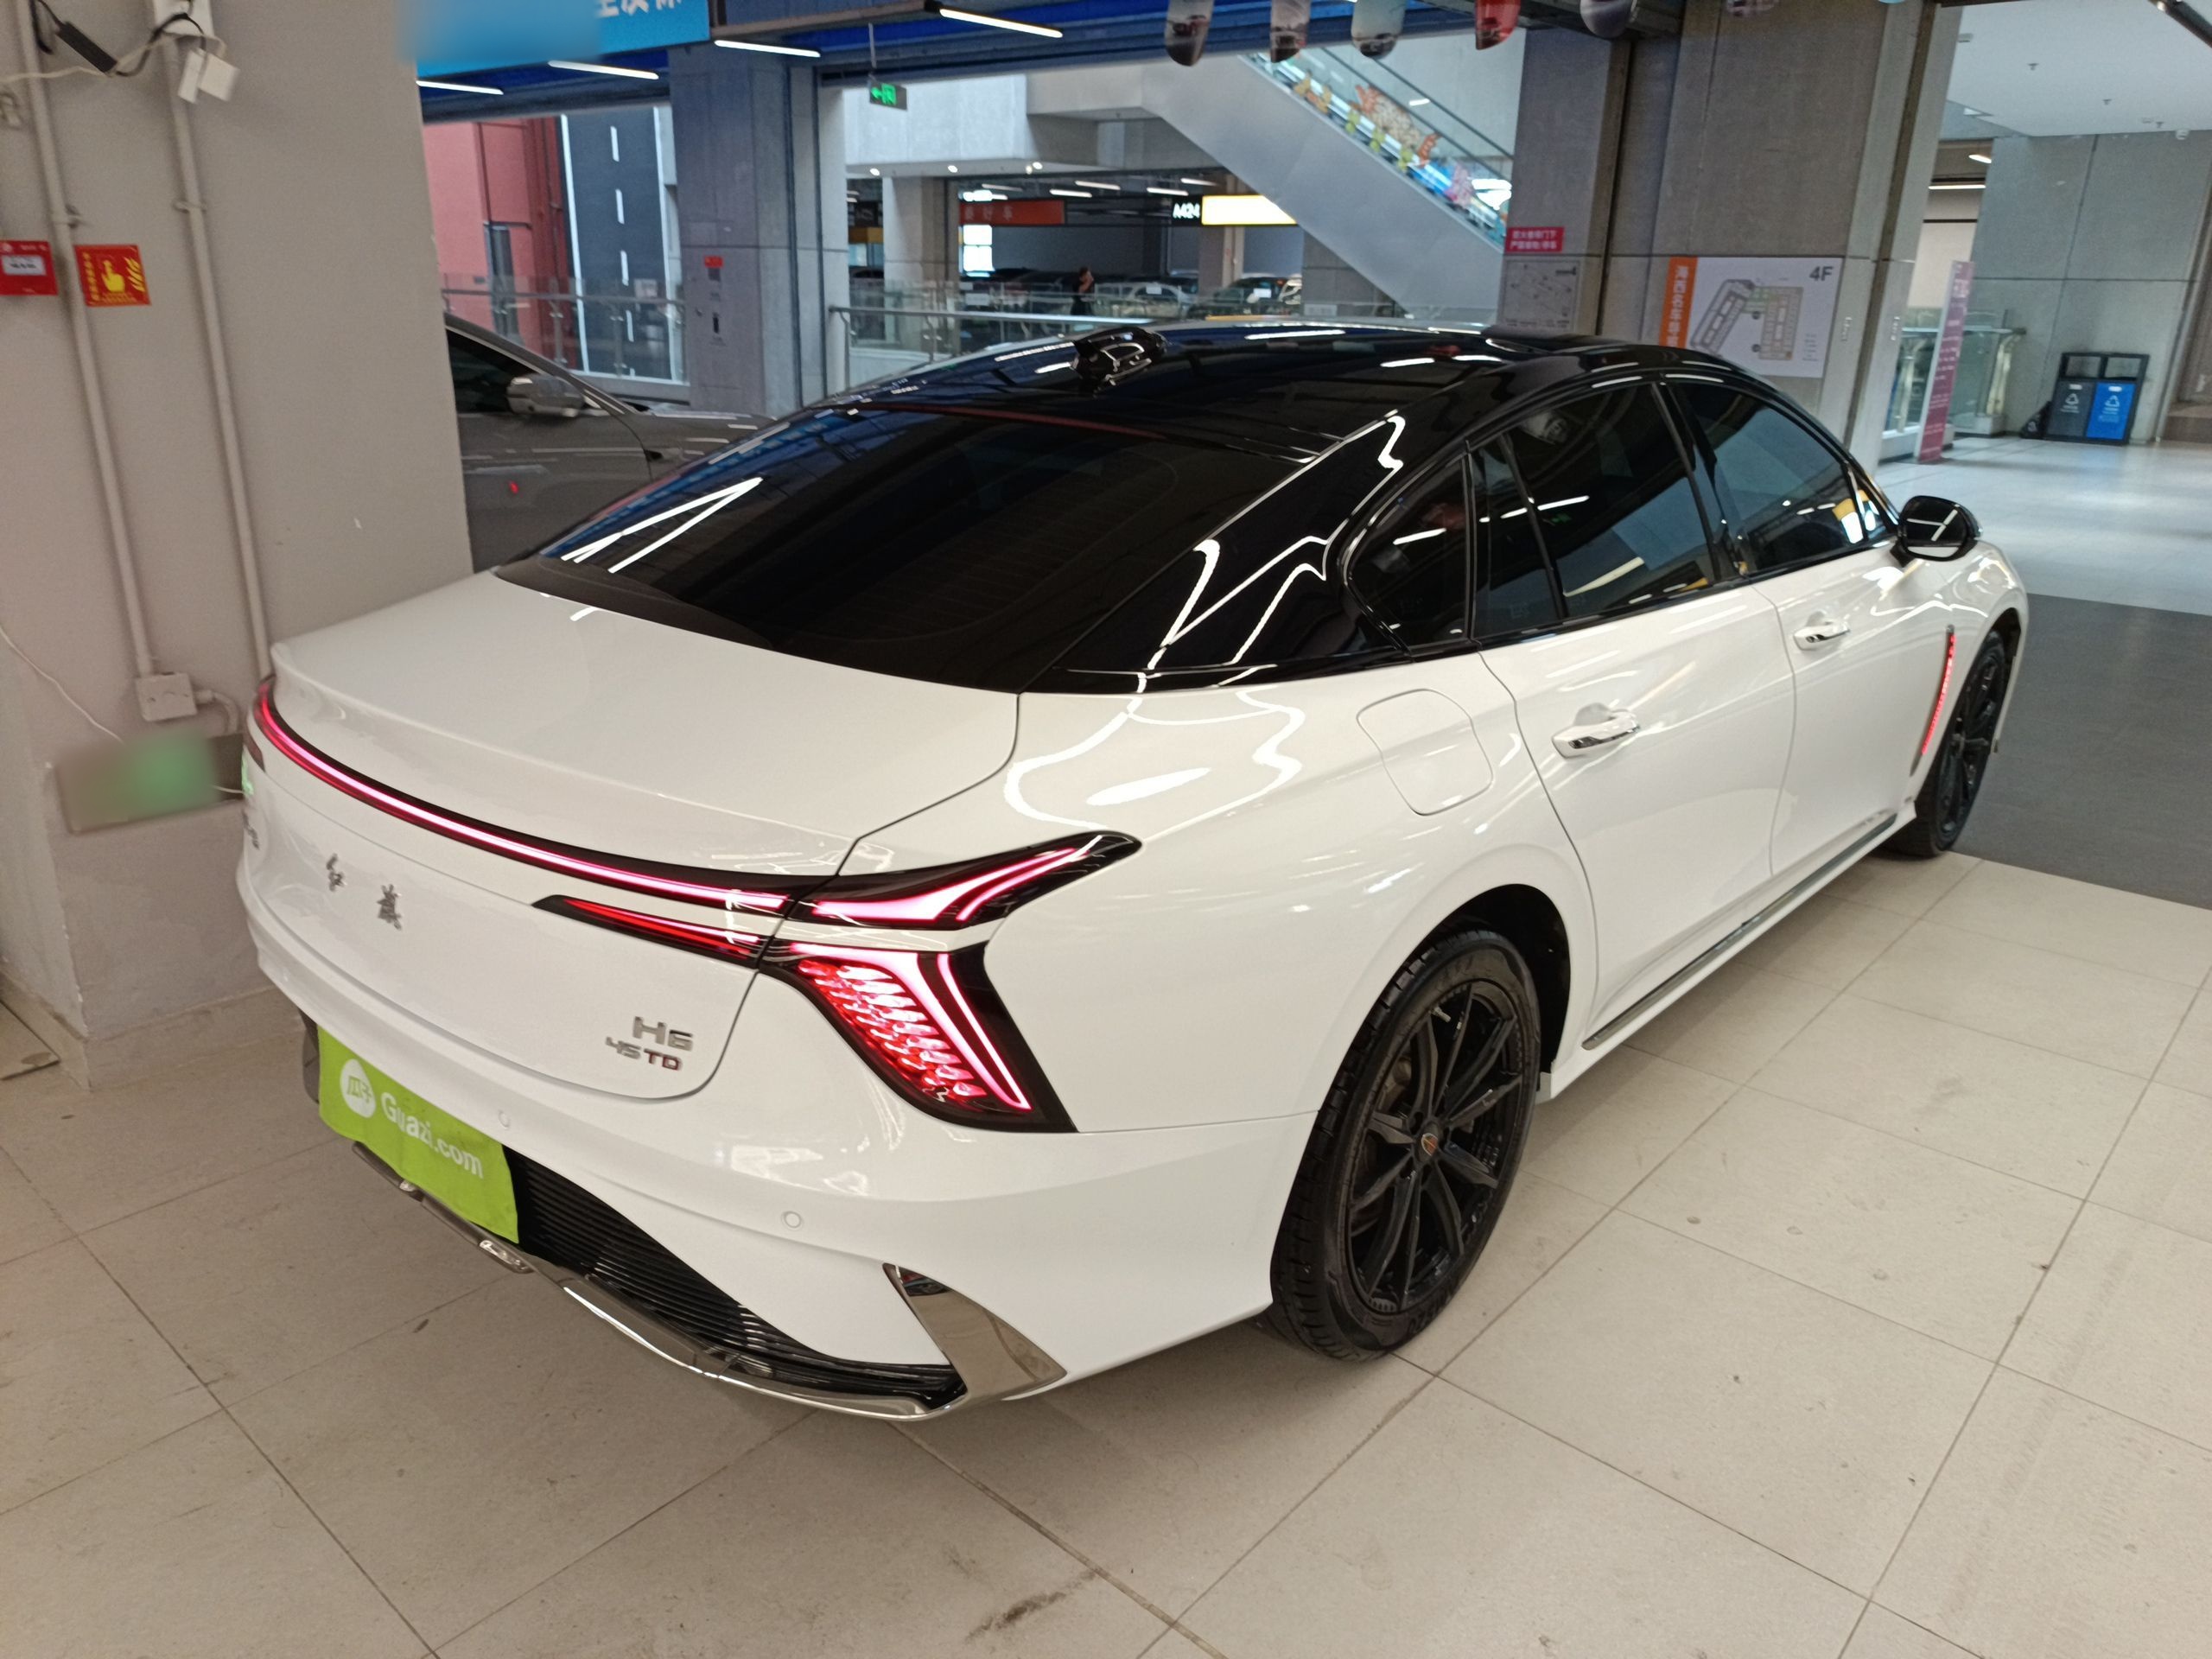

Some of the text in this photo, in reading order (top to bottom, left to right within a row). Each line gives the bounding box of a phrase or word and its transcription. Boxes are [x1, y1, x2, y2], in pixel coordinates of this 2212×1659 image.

[1809, 266, 1834, 282] 4F
[632, 1016, 694, 1052] H6
[380, 1091, 484, 1179] Guazi.com
